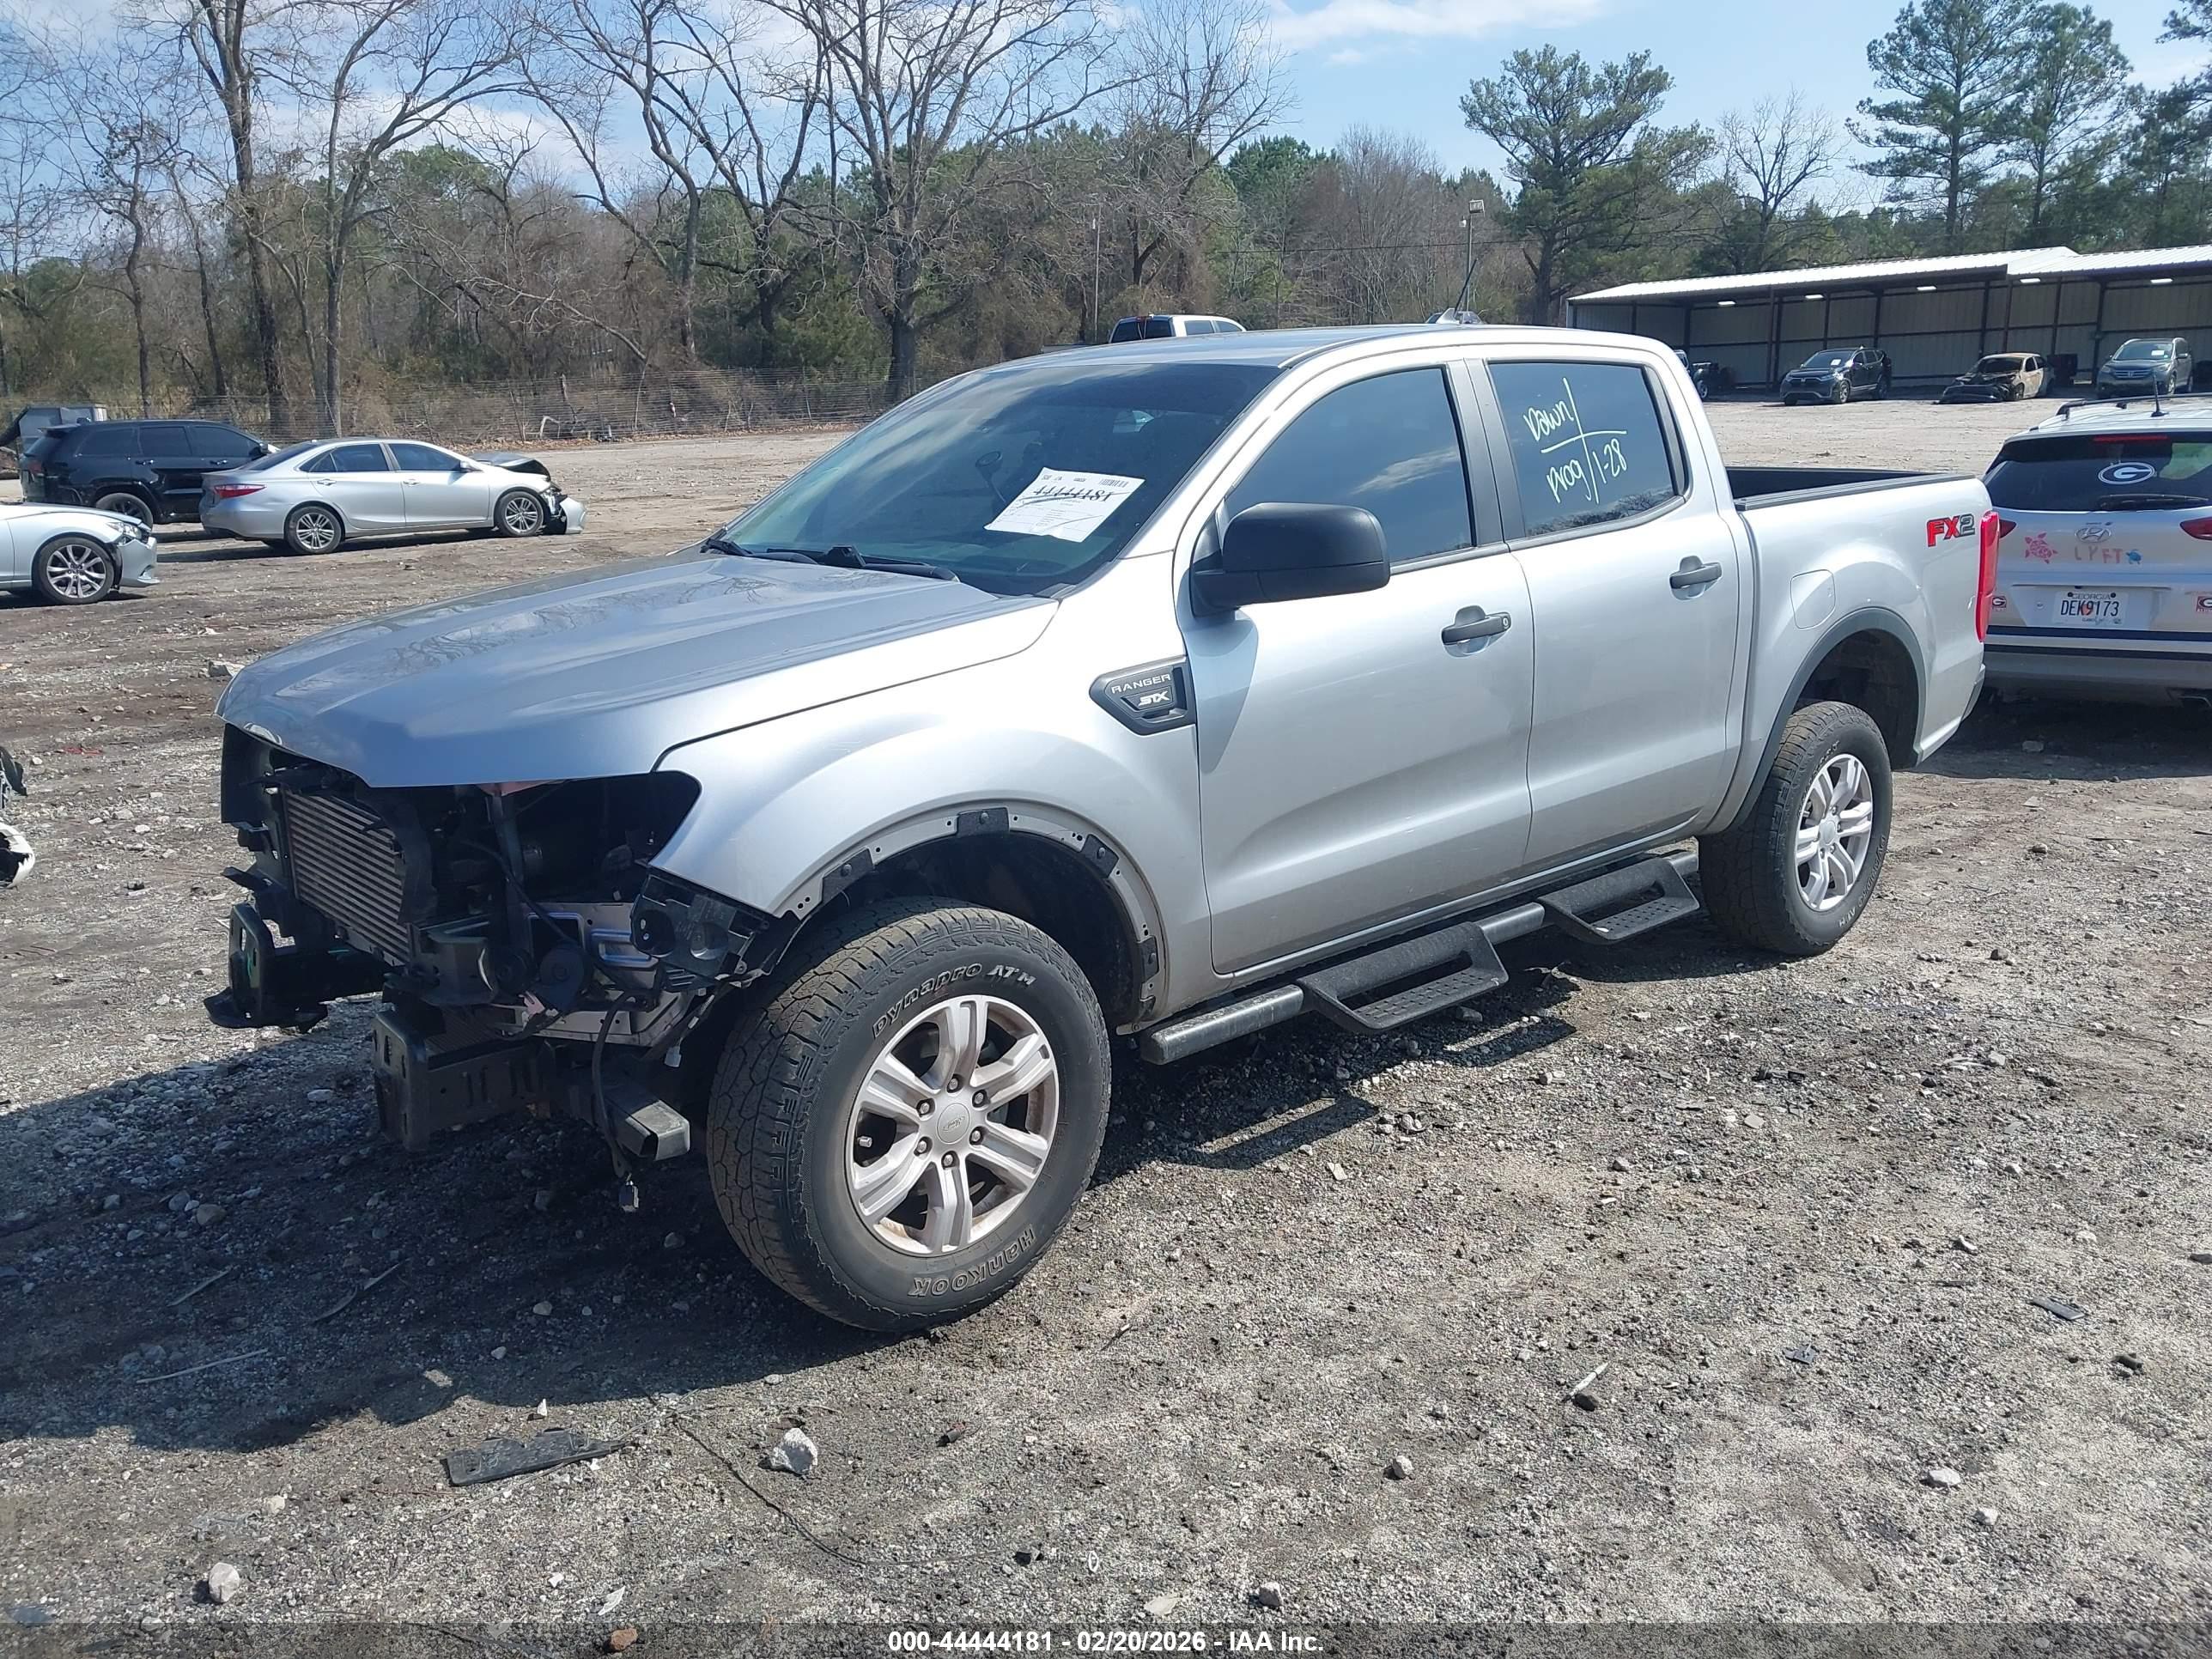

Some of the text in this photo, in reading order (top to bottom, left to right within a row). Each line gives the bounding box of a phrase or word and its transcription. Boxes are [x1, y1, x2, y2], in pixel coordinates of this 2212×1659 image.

[1592, 439, 1627, 484] 1-28
[1926, 514, 1975, 547] FX2
[2071, 592, 2112, 600] GEORGIA
[2060, 600, 2120, 617] DEK9173
[1111, 674, 1171, 694] RANGER
[1138, 690, 1170, 707] STX
